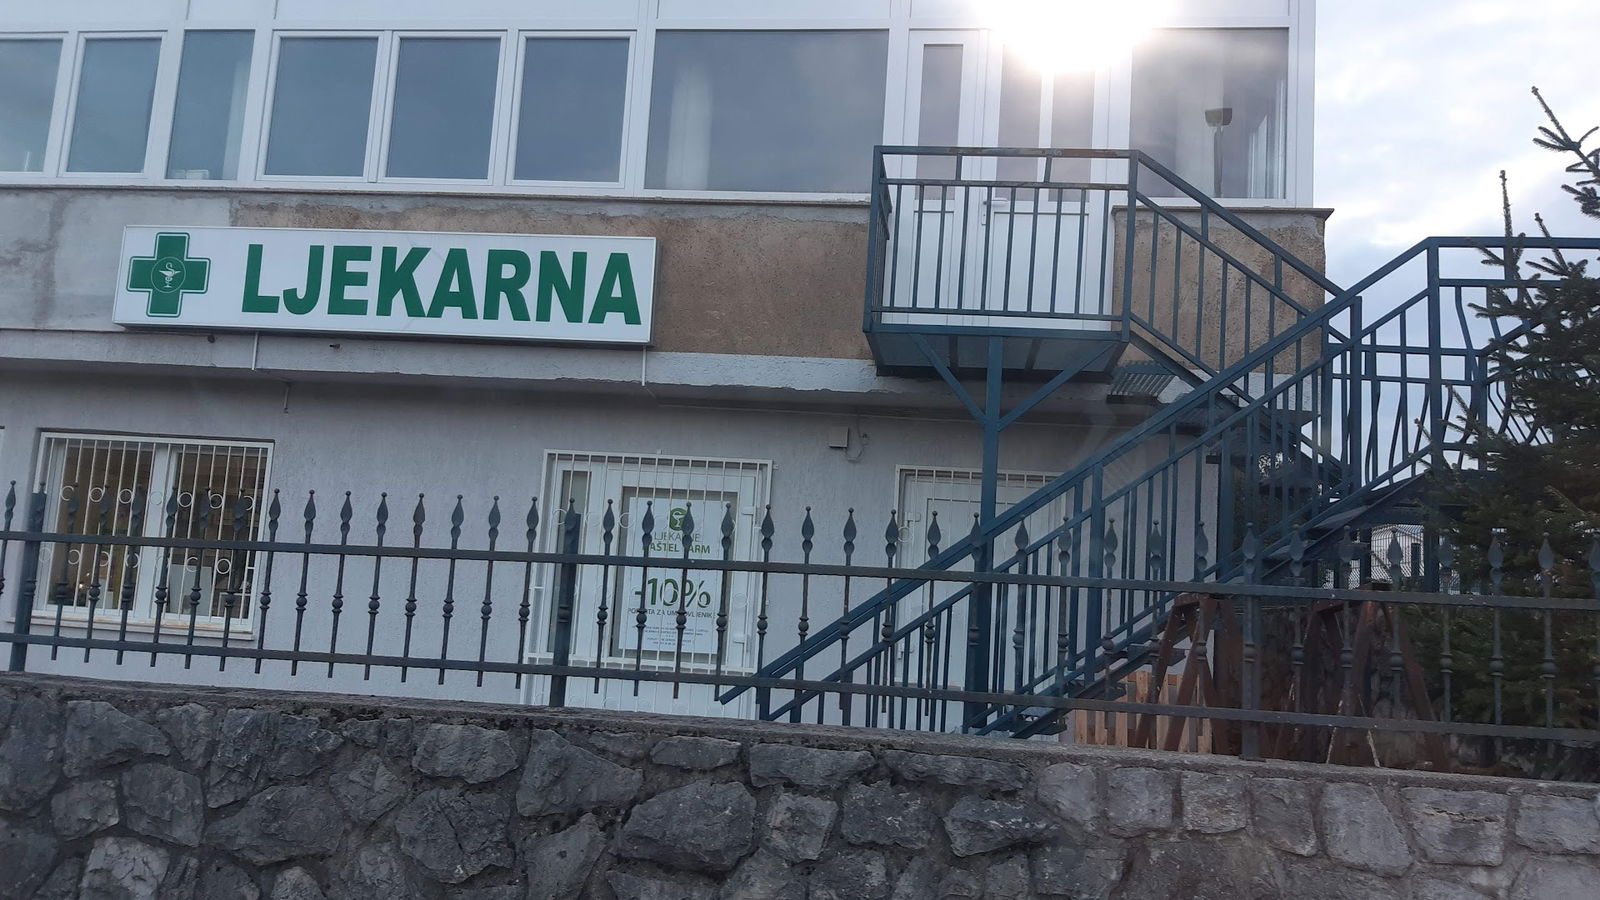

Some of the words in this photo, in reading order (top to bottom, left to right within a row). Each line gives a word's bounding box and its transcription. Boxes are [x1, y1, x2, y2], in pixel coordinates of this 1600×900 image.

[241, 243, 642, 326] LJEKARNA
[643, 541, 680, 553] AŠTEL
[654, 531, 702, 543] LJEKAE
[634, 577, 711, 609] -10%
